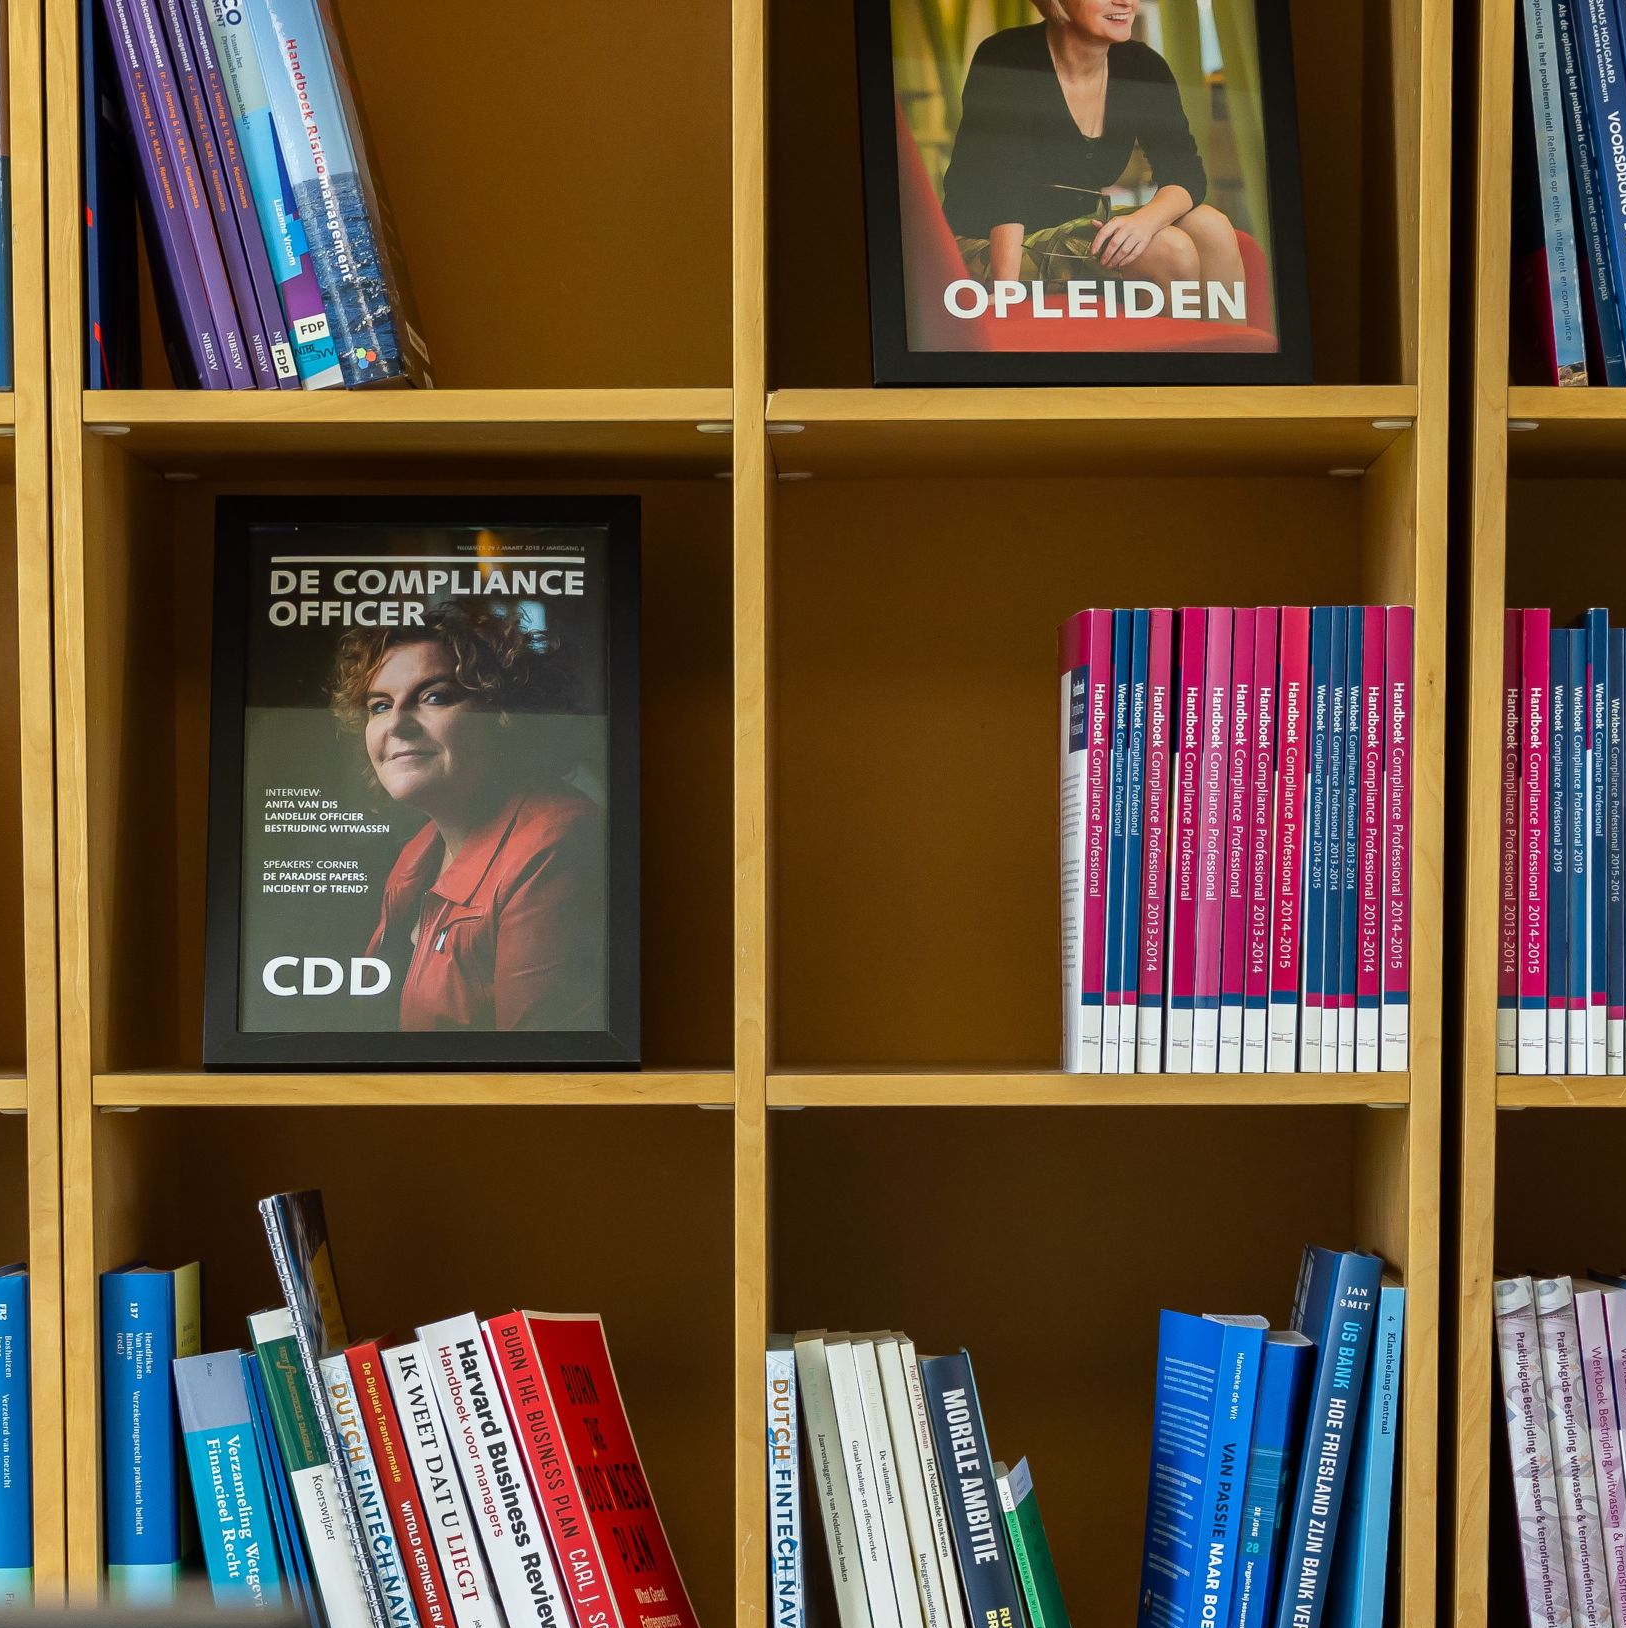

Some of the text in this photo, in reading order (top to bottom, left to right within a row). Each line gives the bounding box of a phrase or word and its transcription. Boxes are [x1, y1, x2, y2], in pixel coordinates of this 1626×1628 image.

[286, 38, 354, 281] Handboek Risicomanagement
[943, 279, 1246, 320] OPLEIDEN
[301, 320, 325, 336] FDP
[275, 348, 290, 375] FDP
[270, 569, 584, 595] DE COMPLIANCE
[268, 600, 426, 627] OFFICER
[265, 788, 322, 797] INTERVIEW:
[265, 800, 338, 809] ANITA VAN DIS
[264, 824, 390, 833] BESTRIJDING WITWASSEN
[265, 812, 364, 821] LANDELIJK OFFICIER
[263, 884, 368, 894] INCIDENT OF TREND?
[262, 956, 391, 997] CDD
[1340, 1298, 1371, 1311] SMIT
[1346, 1286, 1368, 1297] JAN
[1328, 1397, 1346, 1429] HOE
[455, 1339, 502, 1438] Harvard
[487, 1444, 531, 1548] Business
[501, 1325, 580, 1539] BURN THE BUSINESS PLAN
[942, 1388, 999, 1565] MORELE AMBITIE
[1220, 1442, 1237, 1478] VAN
[1314, 1432, 1341, 1517] FRIESLAND
[397, 1353, 479, 1602] IK WEET DAT U LIEGT
[1212, 1481, 1231, 1538] PASSIE
[1308, 1520, 1326, 1554] ZIJN
[1207, 1543, 1225, 1591] NAAR
[1301, 1556, 1319, 1600] BANK
